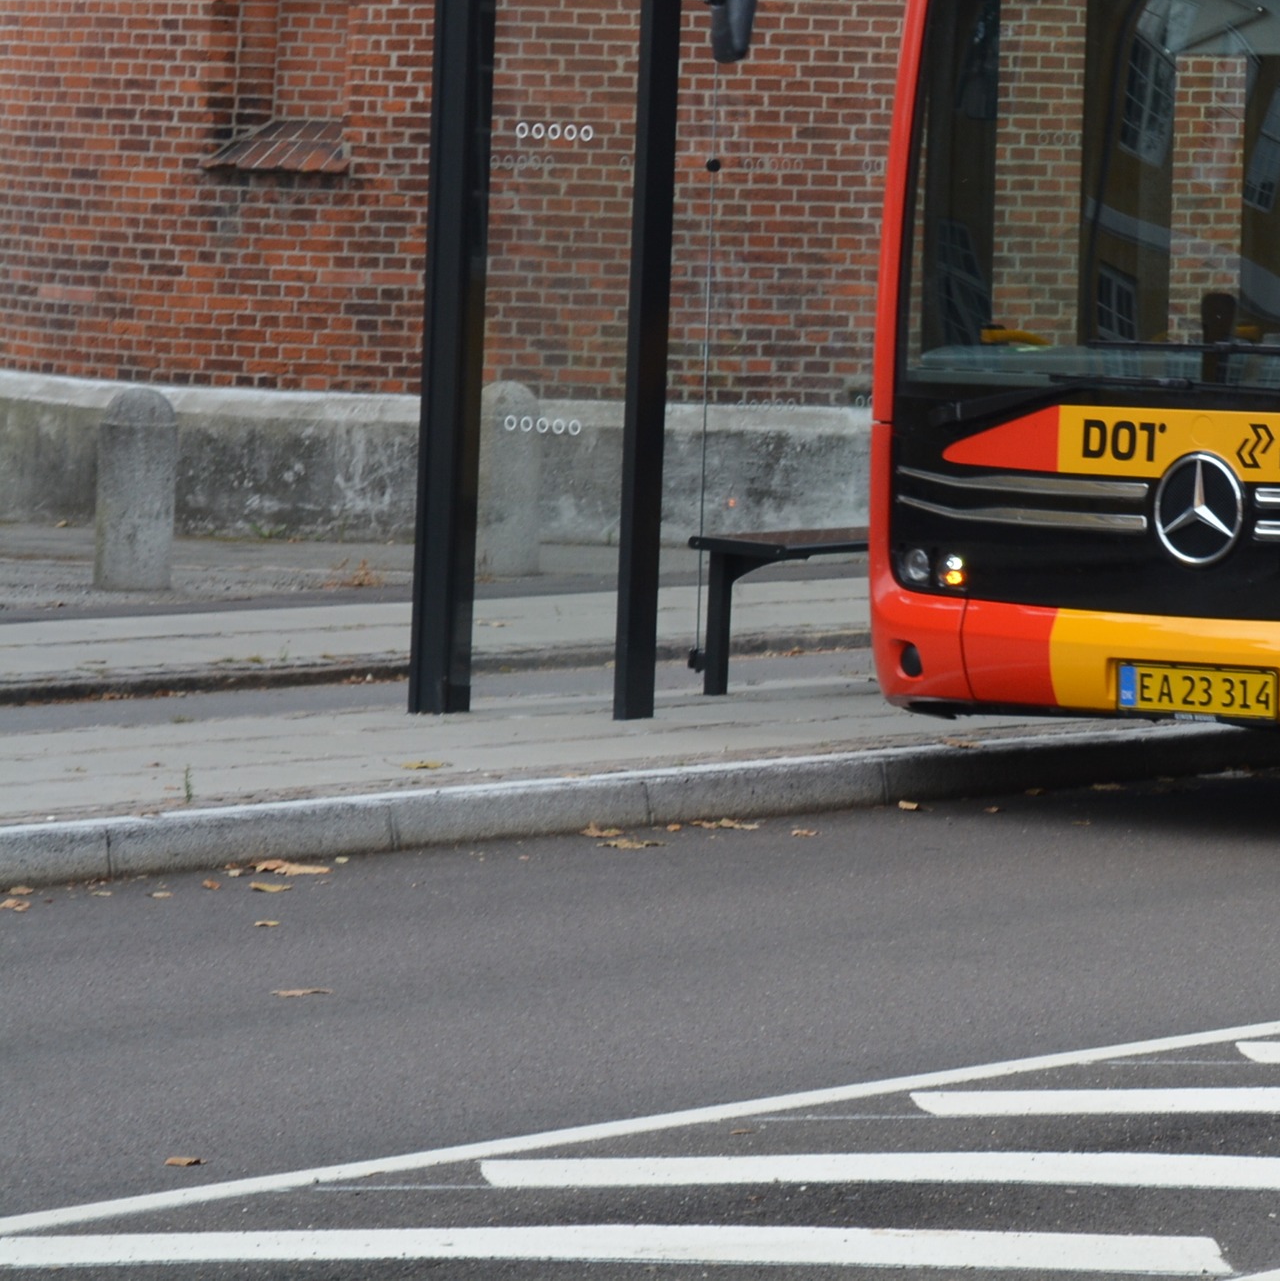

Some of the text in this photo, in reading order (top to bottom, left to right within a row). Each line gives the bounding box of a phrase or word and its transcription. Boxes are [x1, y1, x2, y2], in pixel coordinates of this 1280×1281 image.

[1082, 419, 1167, 462] DOT
[1140, 673, 1270, 710] EA 23 314
